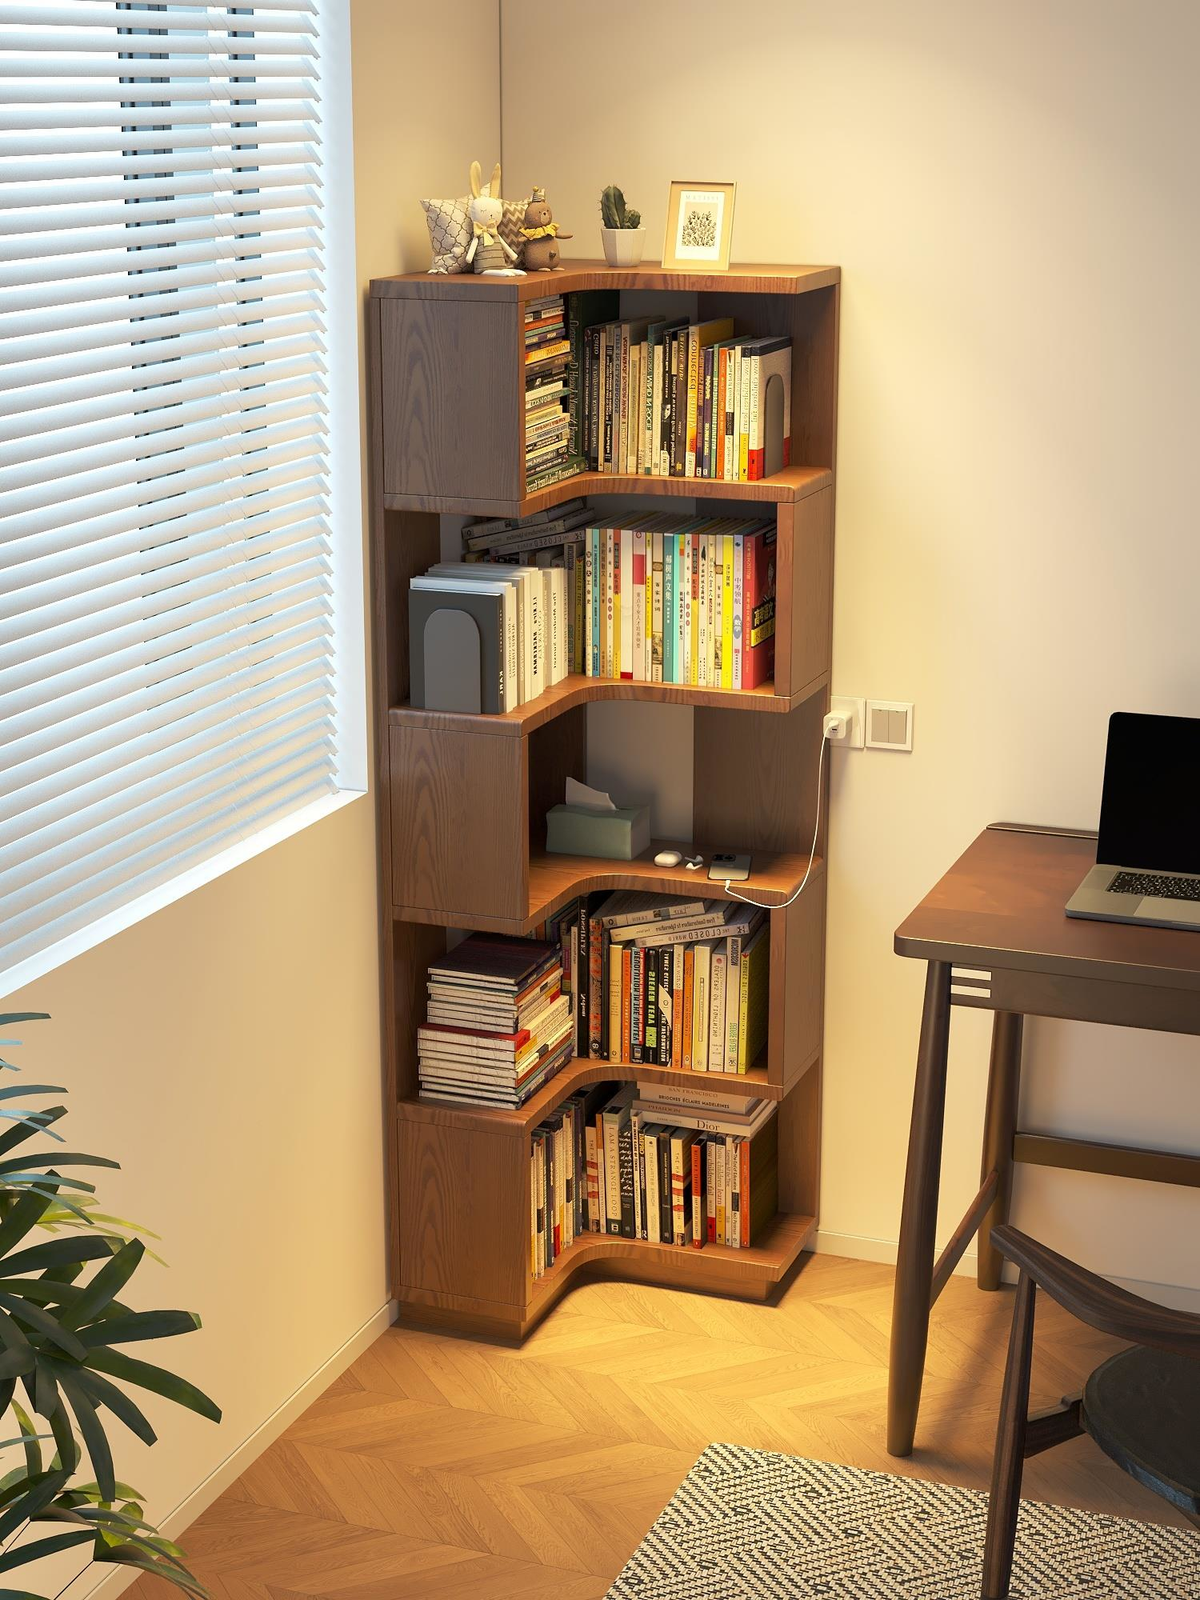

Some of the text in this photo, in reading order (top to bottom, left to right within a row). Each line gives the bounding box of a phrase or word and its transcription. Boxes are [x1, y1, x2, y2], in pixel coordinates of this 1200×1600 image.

[682, 1089, 718, 1098] FRANCISCO
[658, 1094, 730, 1109] BRIOCHES ÉCLAIRS MADELEINES
[696, 1119, 720, 1131] Dior
[609, 1133, 615, 1144] AM
[609, 1155, 617, 1192] STRANGE
[610, 1194, 618, 1217] LOOP
